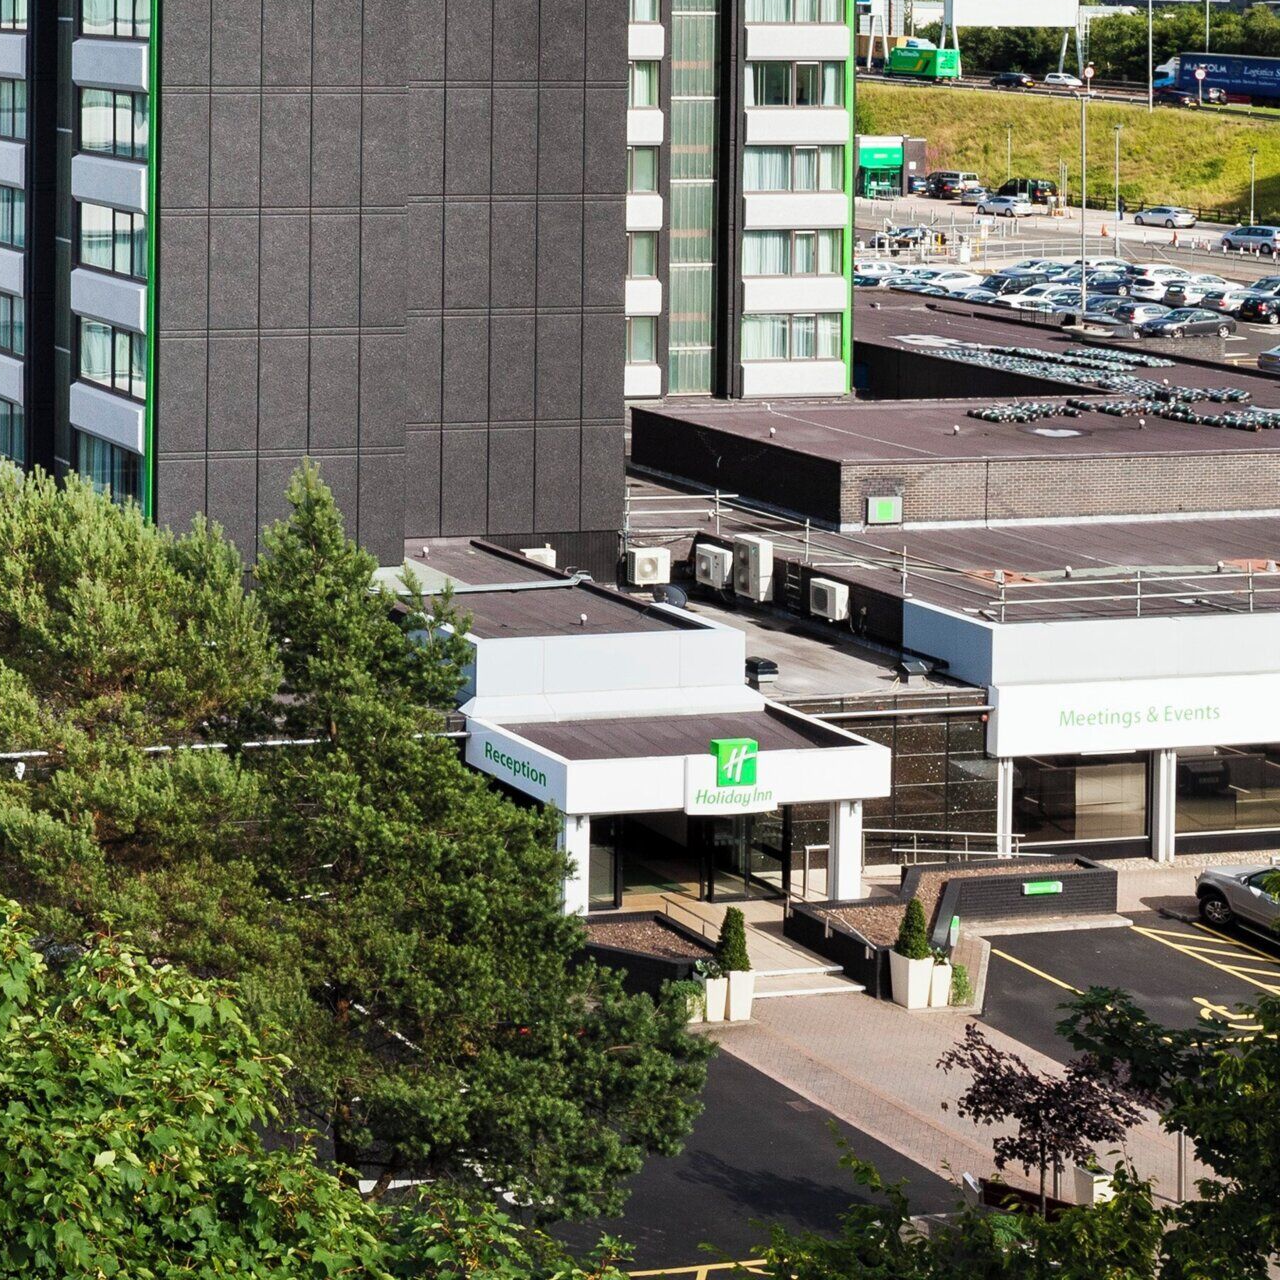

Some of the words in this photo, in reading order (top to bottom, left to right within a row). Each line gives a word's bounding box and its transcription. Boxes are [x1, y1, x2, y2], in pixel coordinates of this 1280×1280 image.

[1059, 708, 1141, 729] Meetings
[1146, 706, 1159, 723] &
[1164, 704, 1221, 722] Events
[484, 740, 547, 788] Reception
[695, 790, 751, 808] Holiday
[752, 787, 772, 803] Inn
